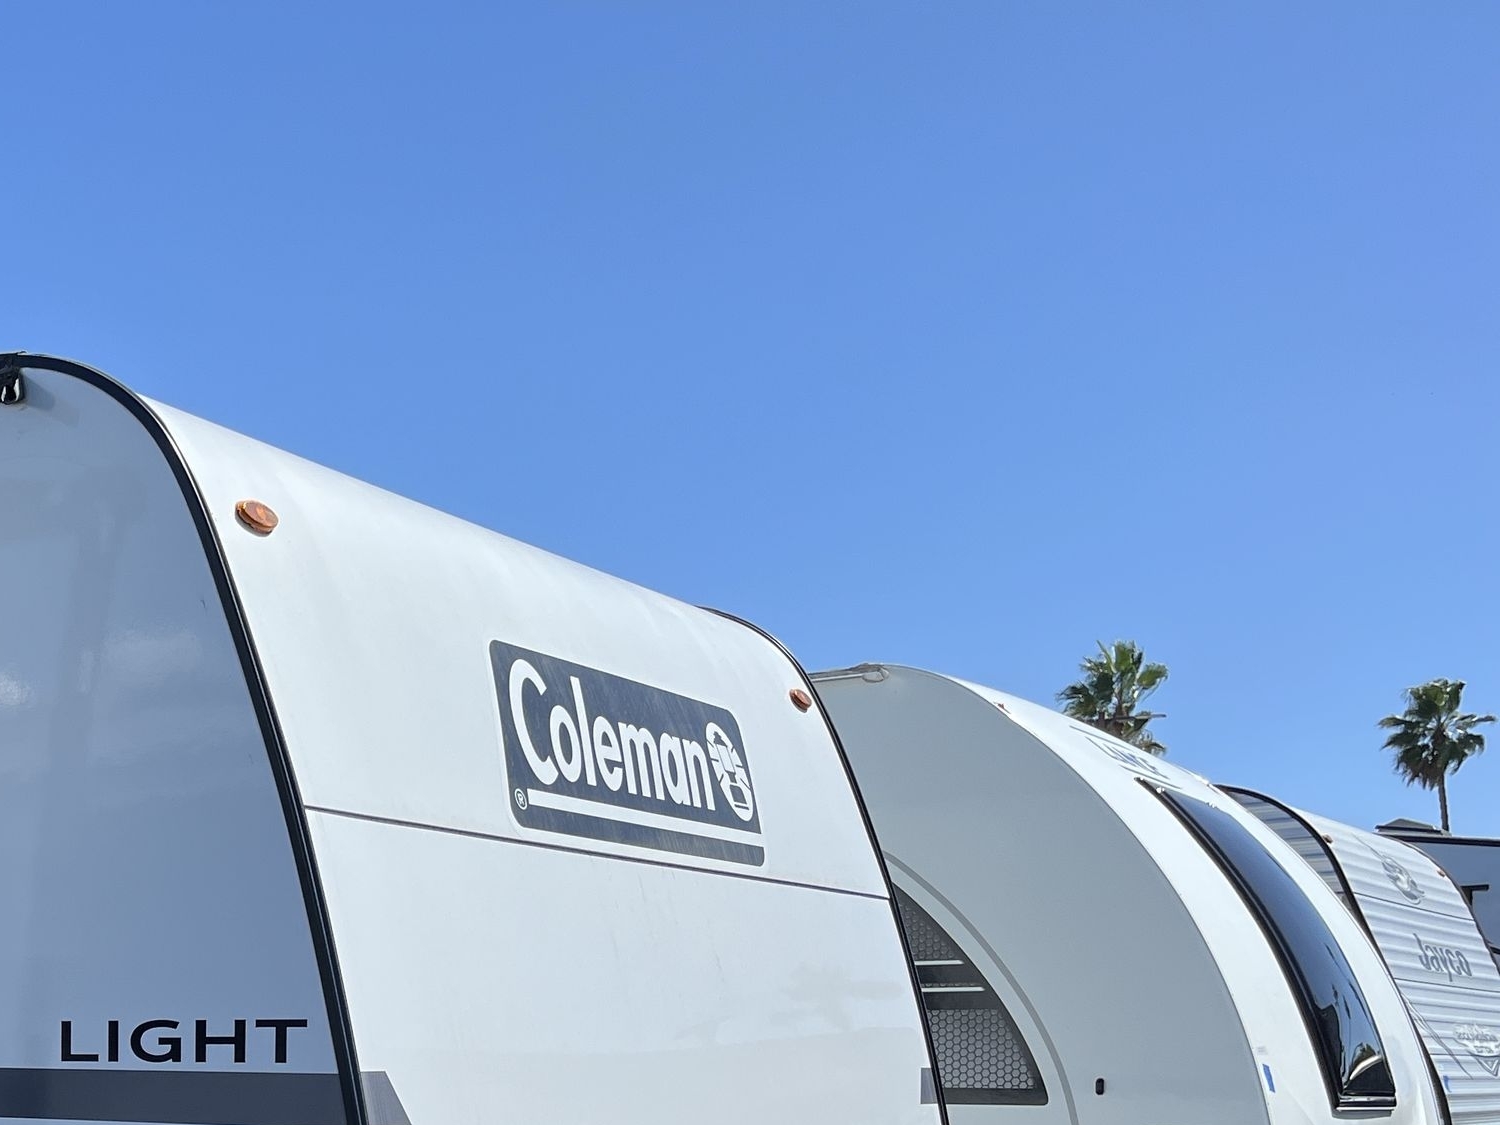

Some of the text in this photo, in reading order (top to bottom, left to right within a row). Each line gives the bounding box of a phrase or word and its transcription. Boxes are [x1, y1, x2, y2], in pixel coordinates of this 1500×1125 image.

[509, 658, 716, 811] Coleman
[1413, 933, 1473, 982] Jayco
[61, 1019, 308, 1064] LIGHT
